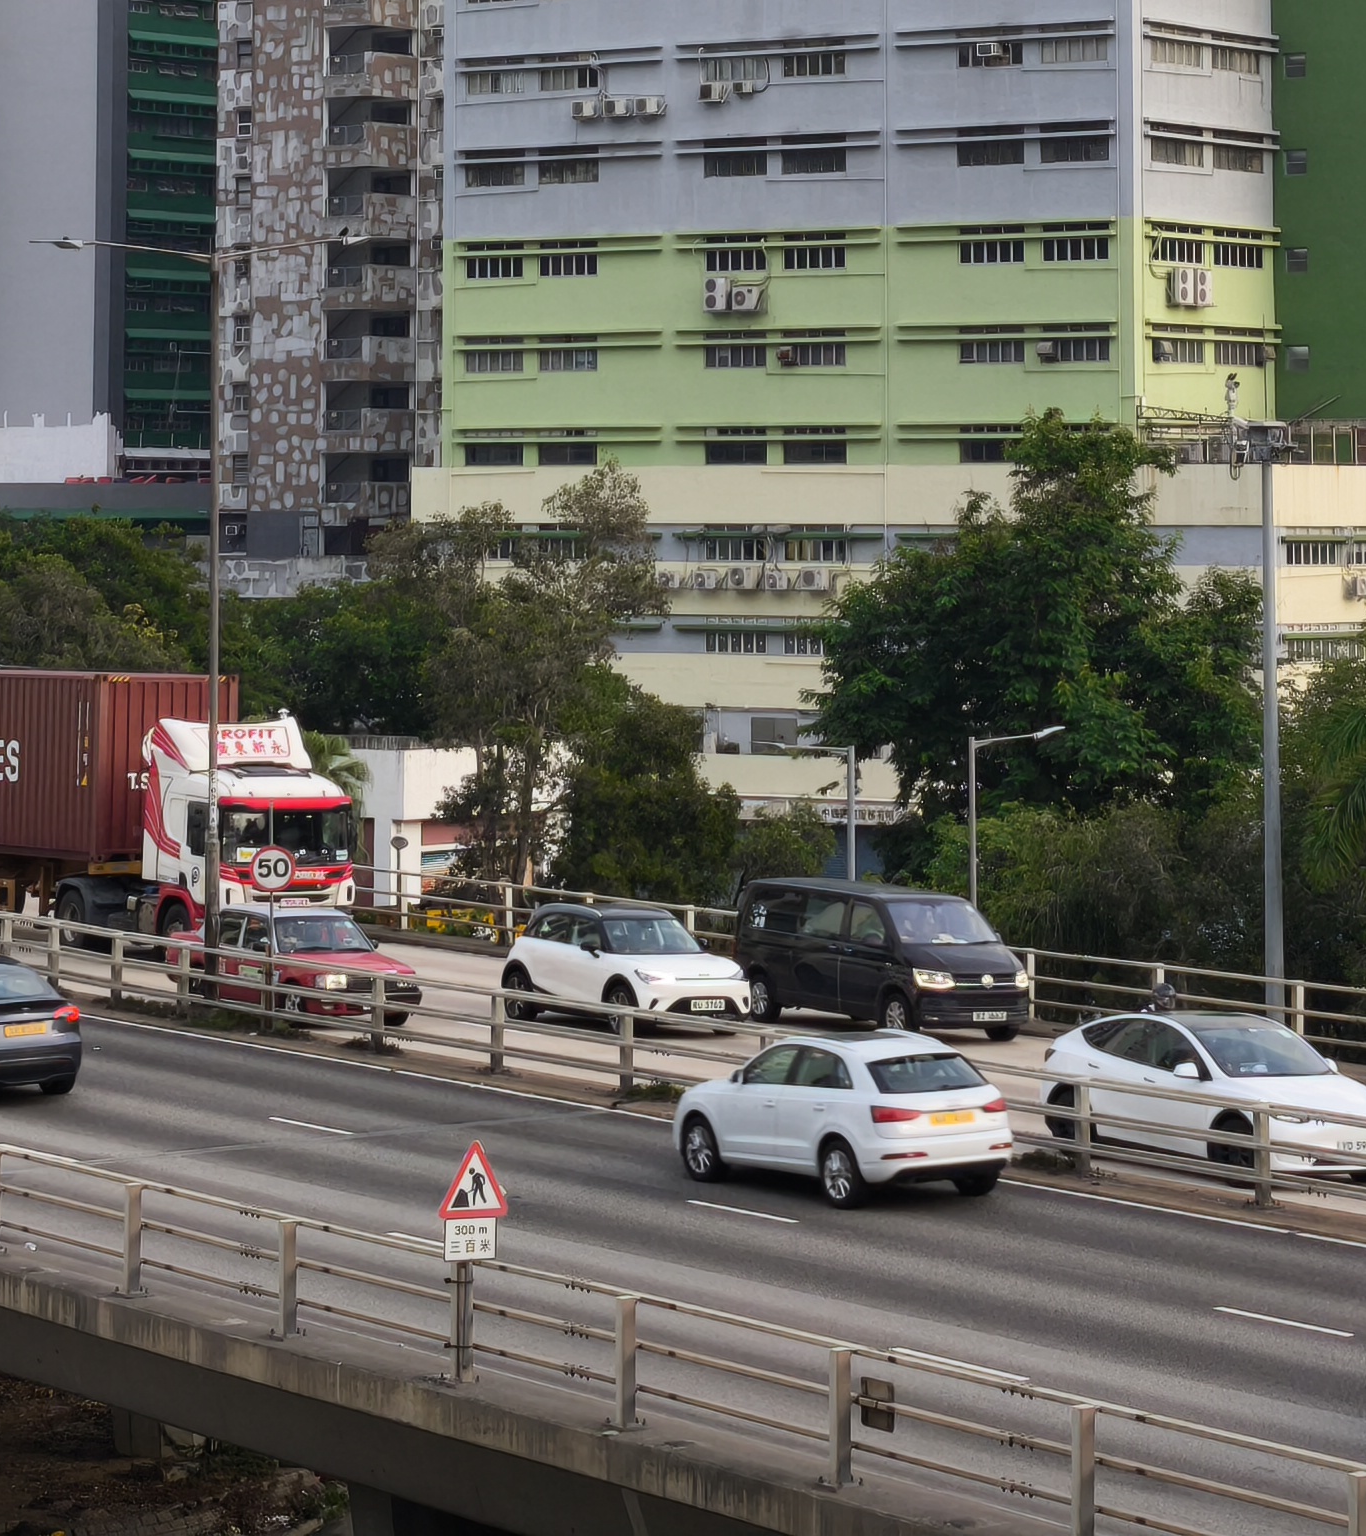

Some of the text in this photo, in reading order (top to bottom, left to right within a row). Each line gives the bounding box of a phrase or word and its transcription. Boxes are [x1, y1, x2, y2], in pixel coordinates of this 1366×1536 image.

[216, 728, 276, 740] ROFIT
[257, 857, 290, 879] 50
[454, 1224, 488, 1236] 300 m
[449, 1238, 492, 1254] 三百米
